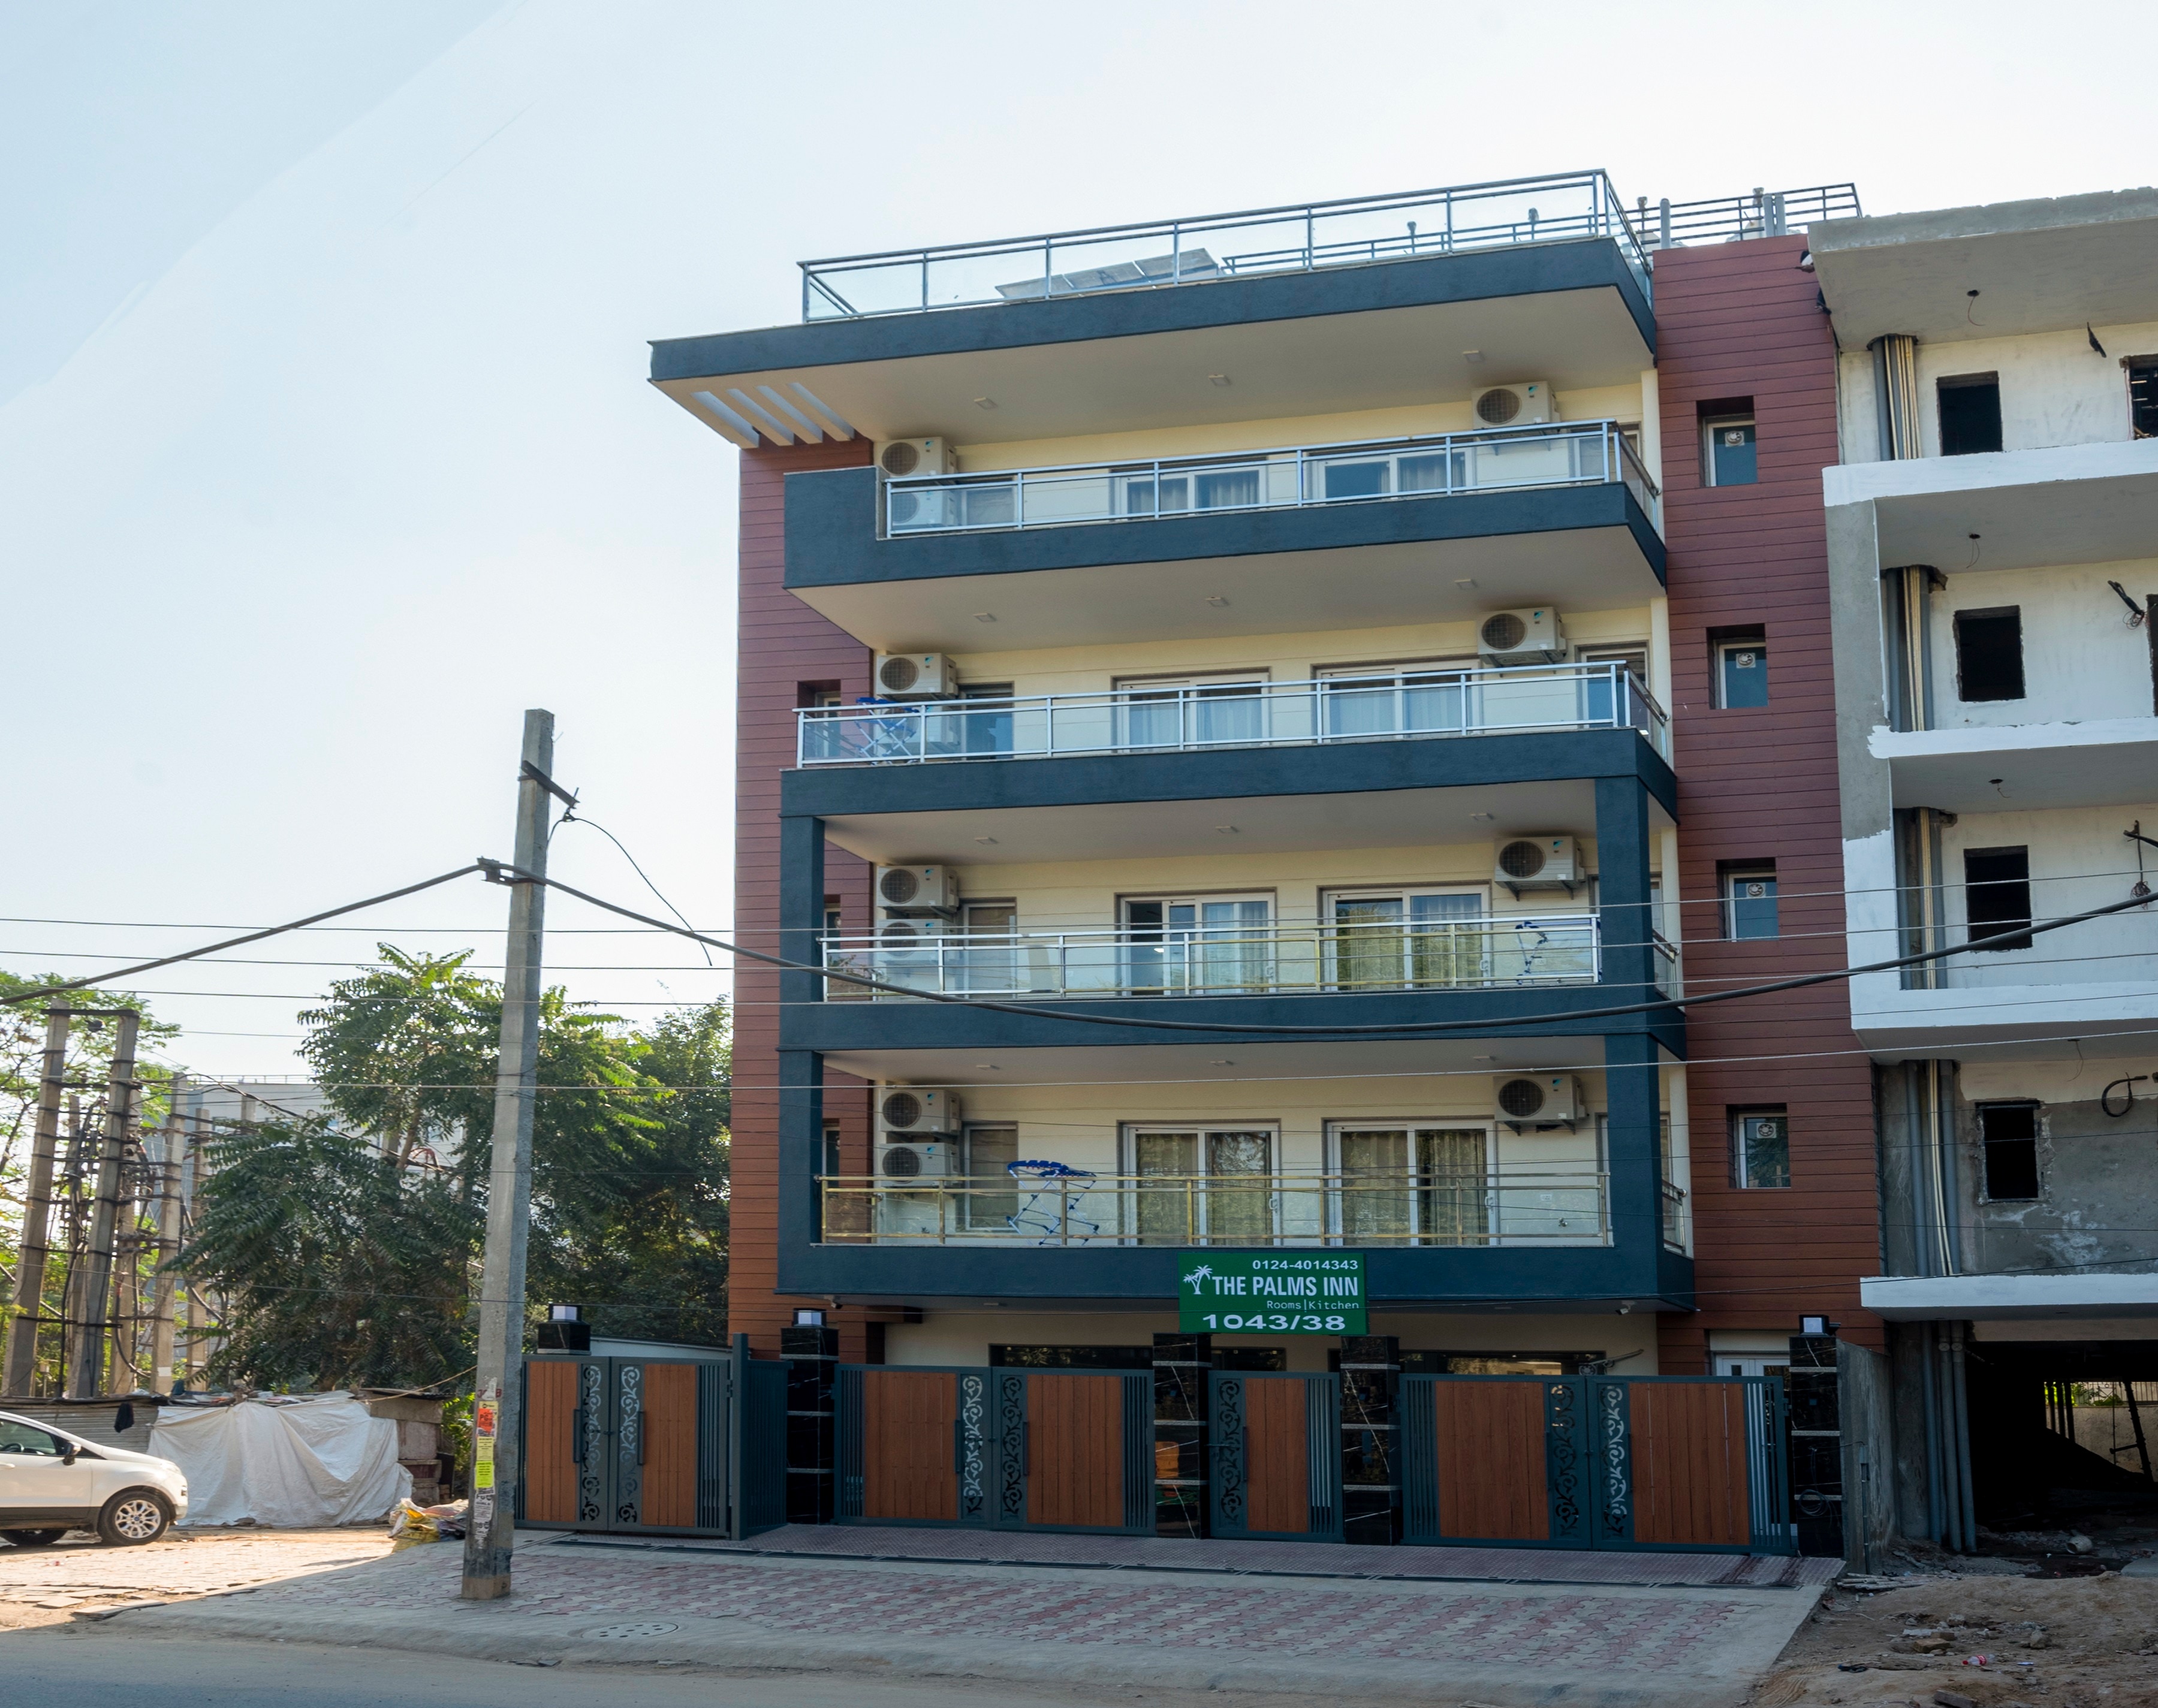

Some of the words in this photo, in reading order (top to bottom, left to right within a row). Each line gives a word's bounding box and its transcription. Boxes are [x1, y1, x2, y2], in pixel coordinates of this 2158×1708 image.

[1252, 1260, 1358, 1270] 0124-4014343
[1211, 1276, 1246, 1295] THE
[1253, 1277, 1317, 1296] PALMS
[1324, 1277, 1358, 1296] INN
[1267, 1300, 1301, 1309] Rooms
[1309, 1300, 1360, 1310] Kitchen
[1202, 1314, 1346, 1330] 1043/38
